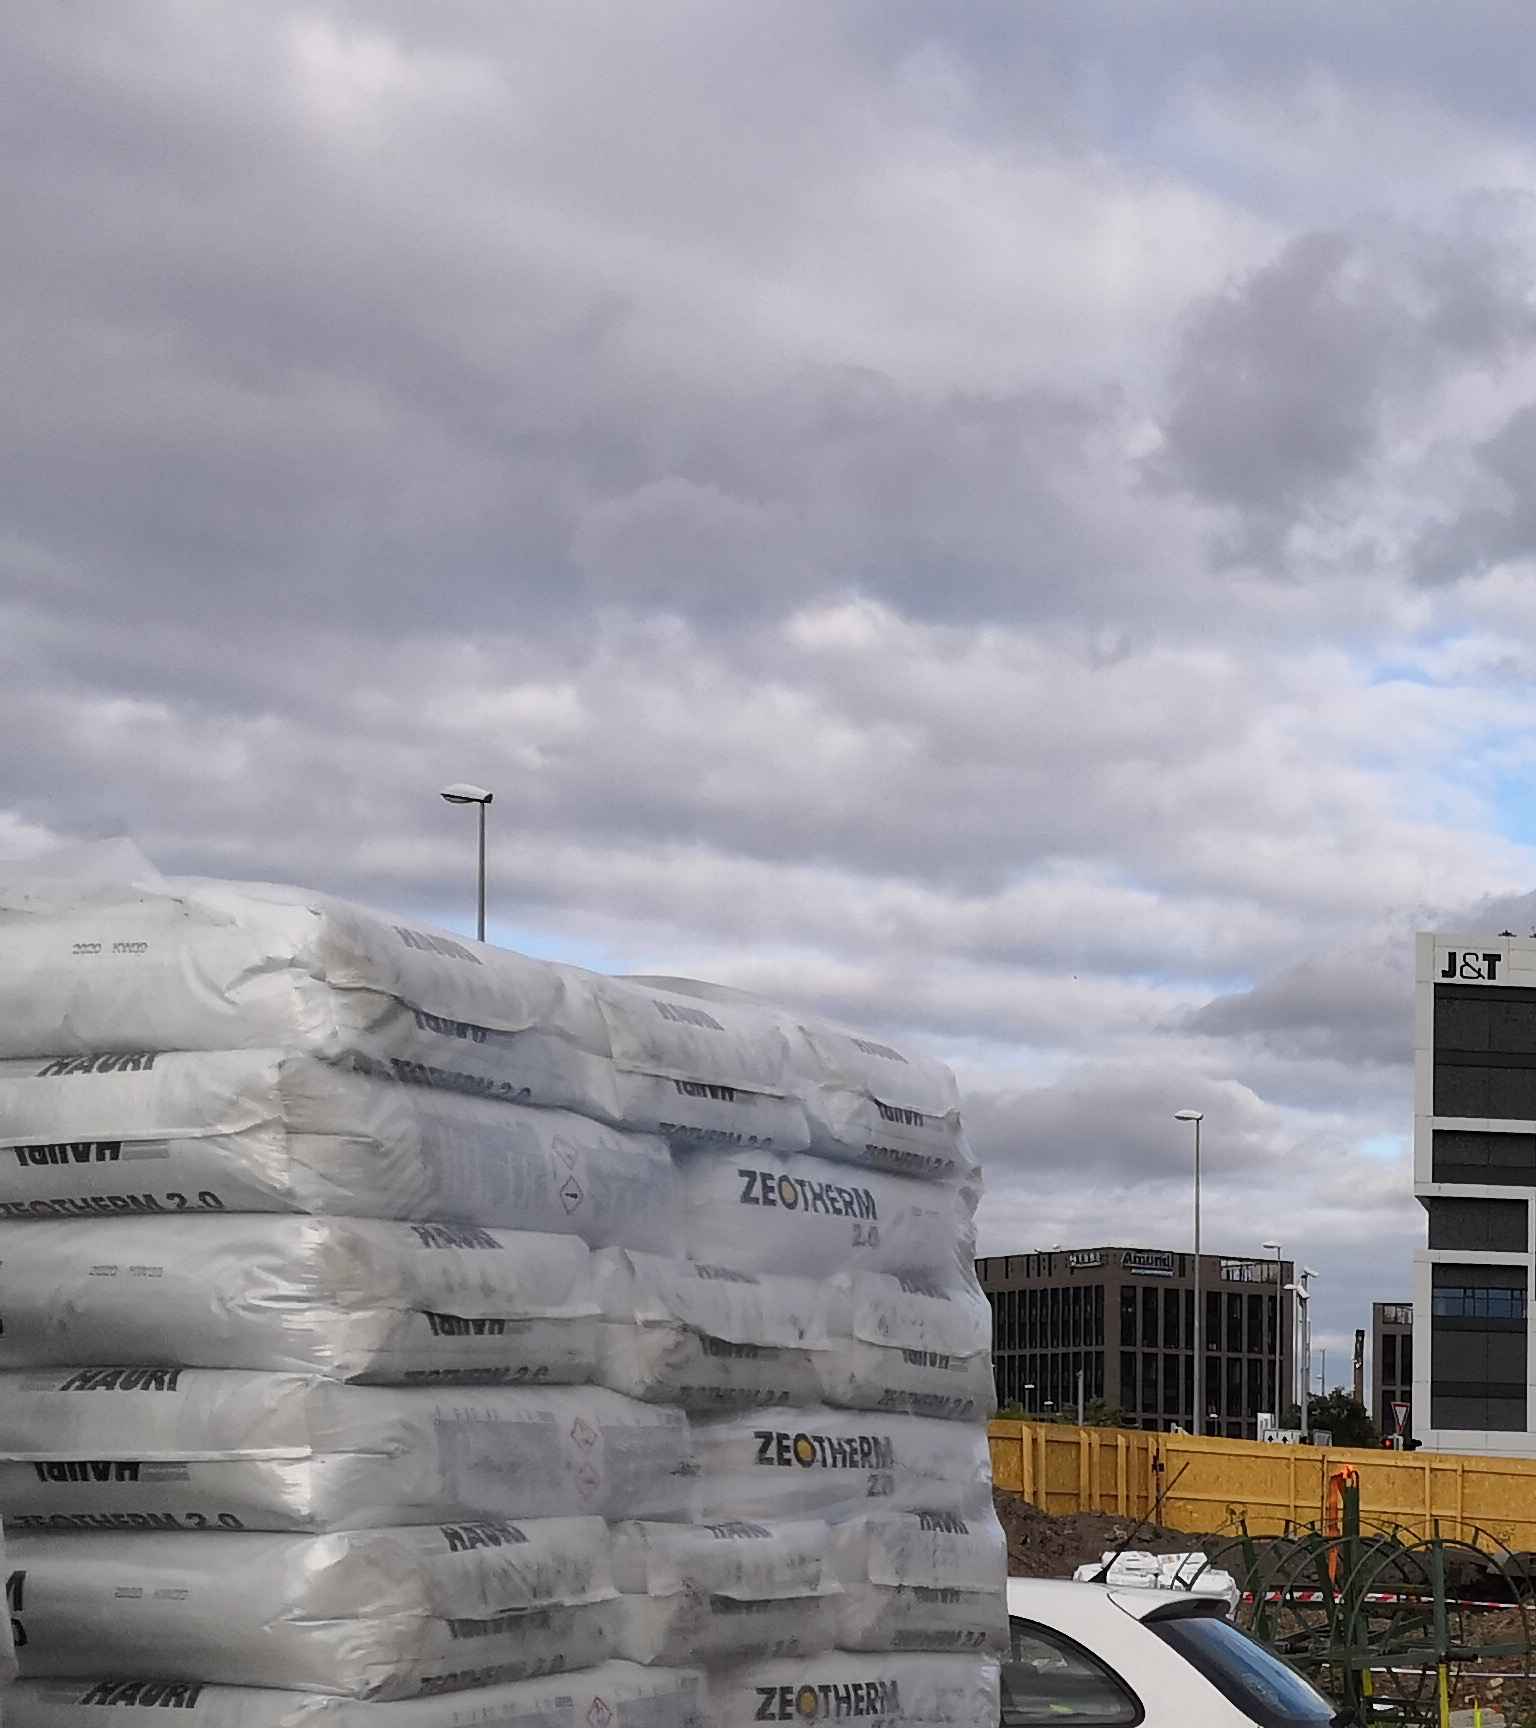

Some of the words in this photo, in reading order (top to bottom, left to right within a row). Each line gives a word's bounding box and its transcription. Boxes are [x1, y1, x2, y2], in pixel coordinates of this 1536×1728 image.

[1441, 951, 1501, 981] J&T
[737, 1169, 878, 1220] ZEOTHERM
[752, 1431, 894, 1470] ZEOTHERM
[754, 1680, 900, 1722] ZEOTHERM
